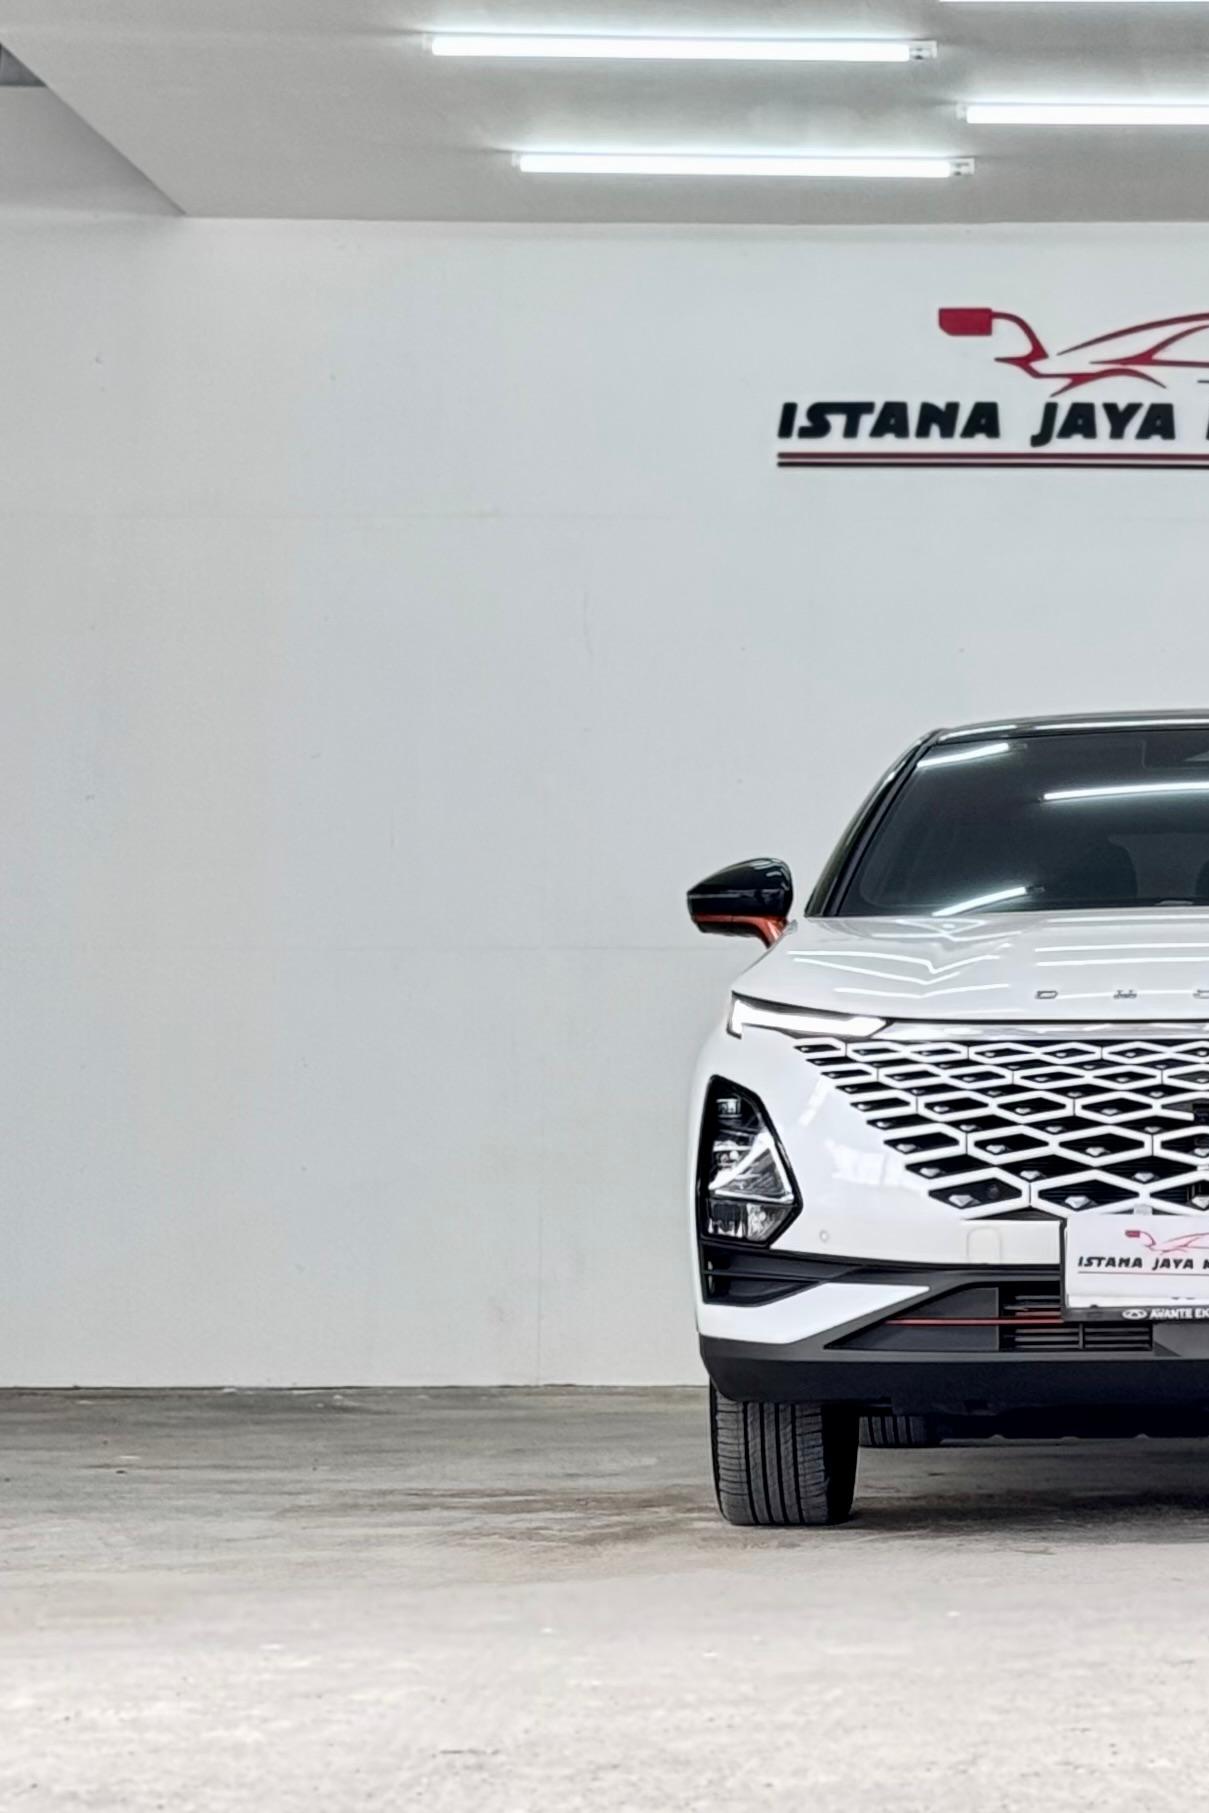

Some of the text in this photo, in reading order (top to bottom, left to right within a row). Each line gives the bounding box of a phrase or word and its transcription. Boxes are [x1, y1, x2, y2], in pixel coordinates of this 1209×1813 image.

[777, 401, 1001, 439] ISTANA
[1030, 401, 1176, 447] JAYA
[1077, 1256, 1143, 1269] ISTANA
[1151, 1257, 1194, 1271] JAYA
